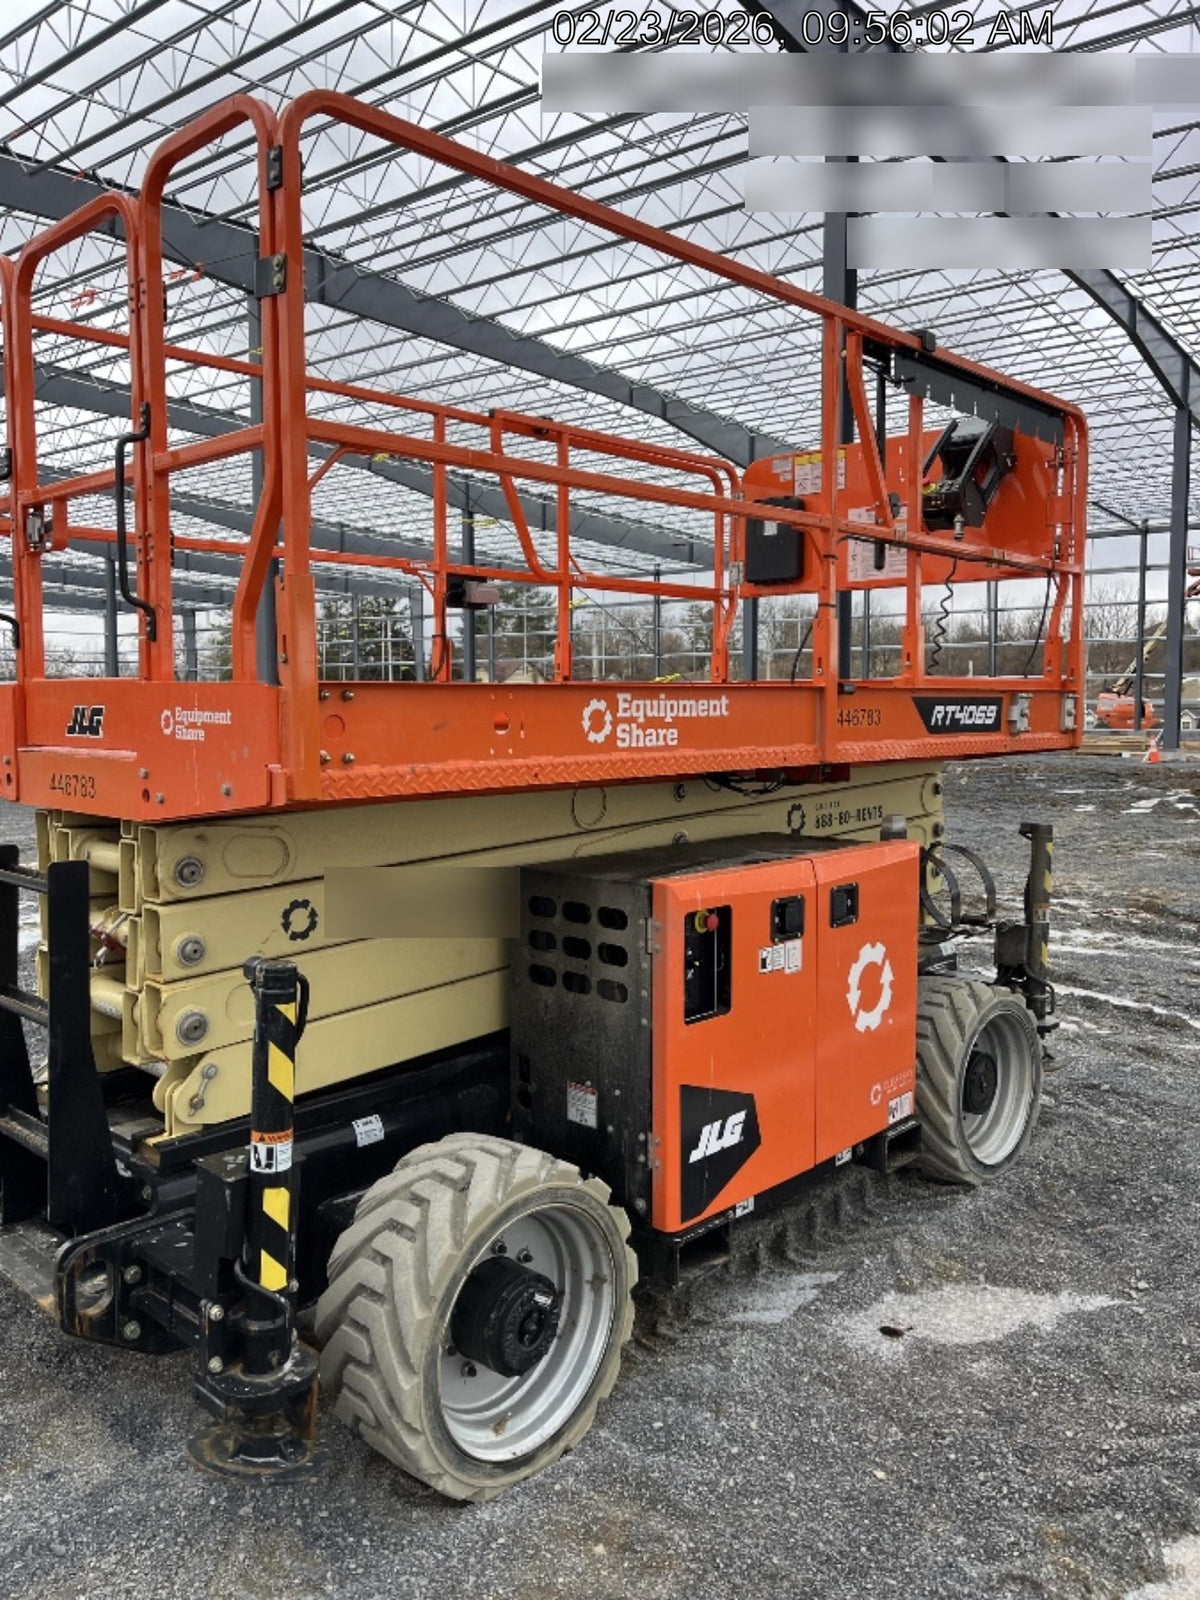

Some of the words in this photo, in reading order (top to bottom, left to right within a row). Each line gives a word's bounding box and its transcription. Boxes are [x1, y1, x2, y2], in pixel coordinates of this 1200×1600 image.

[175, 706, 232, 726] Equipment
[616, 692, 729, 723] Equipment
[837, 708, 881, 727] 446783
[930, 705, 998, 726] RT4069
[65, 706, 105, 738] JLG
[175, 724, 205, 741] Share
[616, 723, 678, 747] Share
[50, 772, 96, 799] 446783
[688, 1109, 747, 1163] JLG
